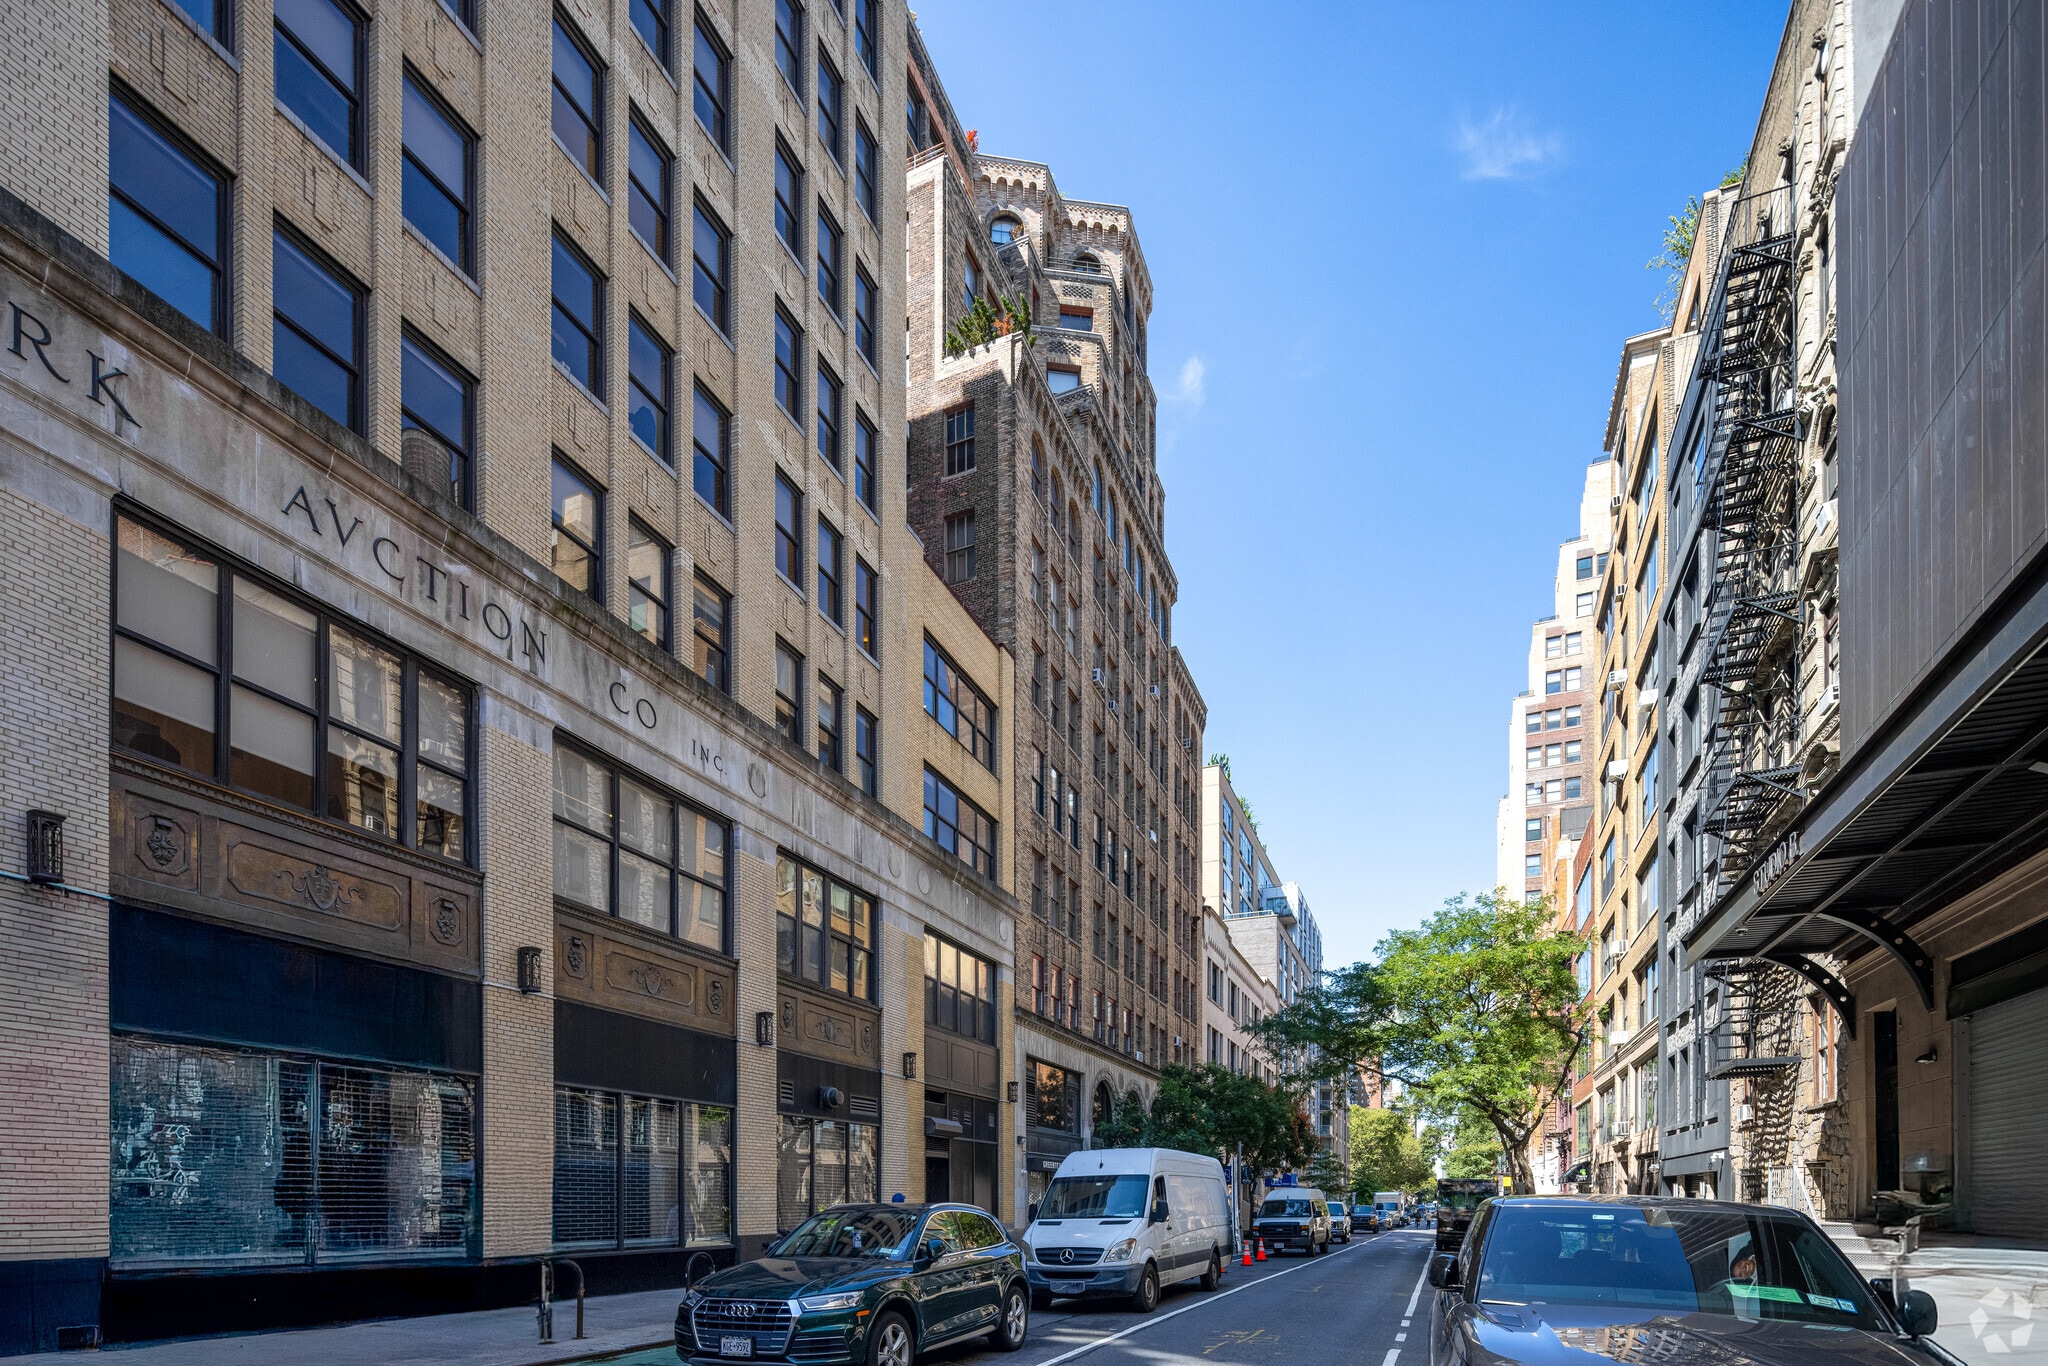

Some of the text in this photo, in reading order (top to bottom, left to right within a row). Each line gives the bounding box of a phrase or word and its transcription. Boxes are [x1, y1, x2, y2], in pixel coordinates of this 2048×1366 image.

[7, 301, 728, 775] RK AVCTION CO INC.
